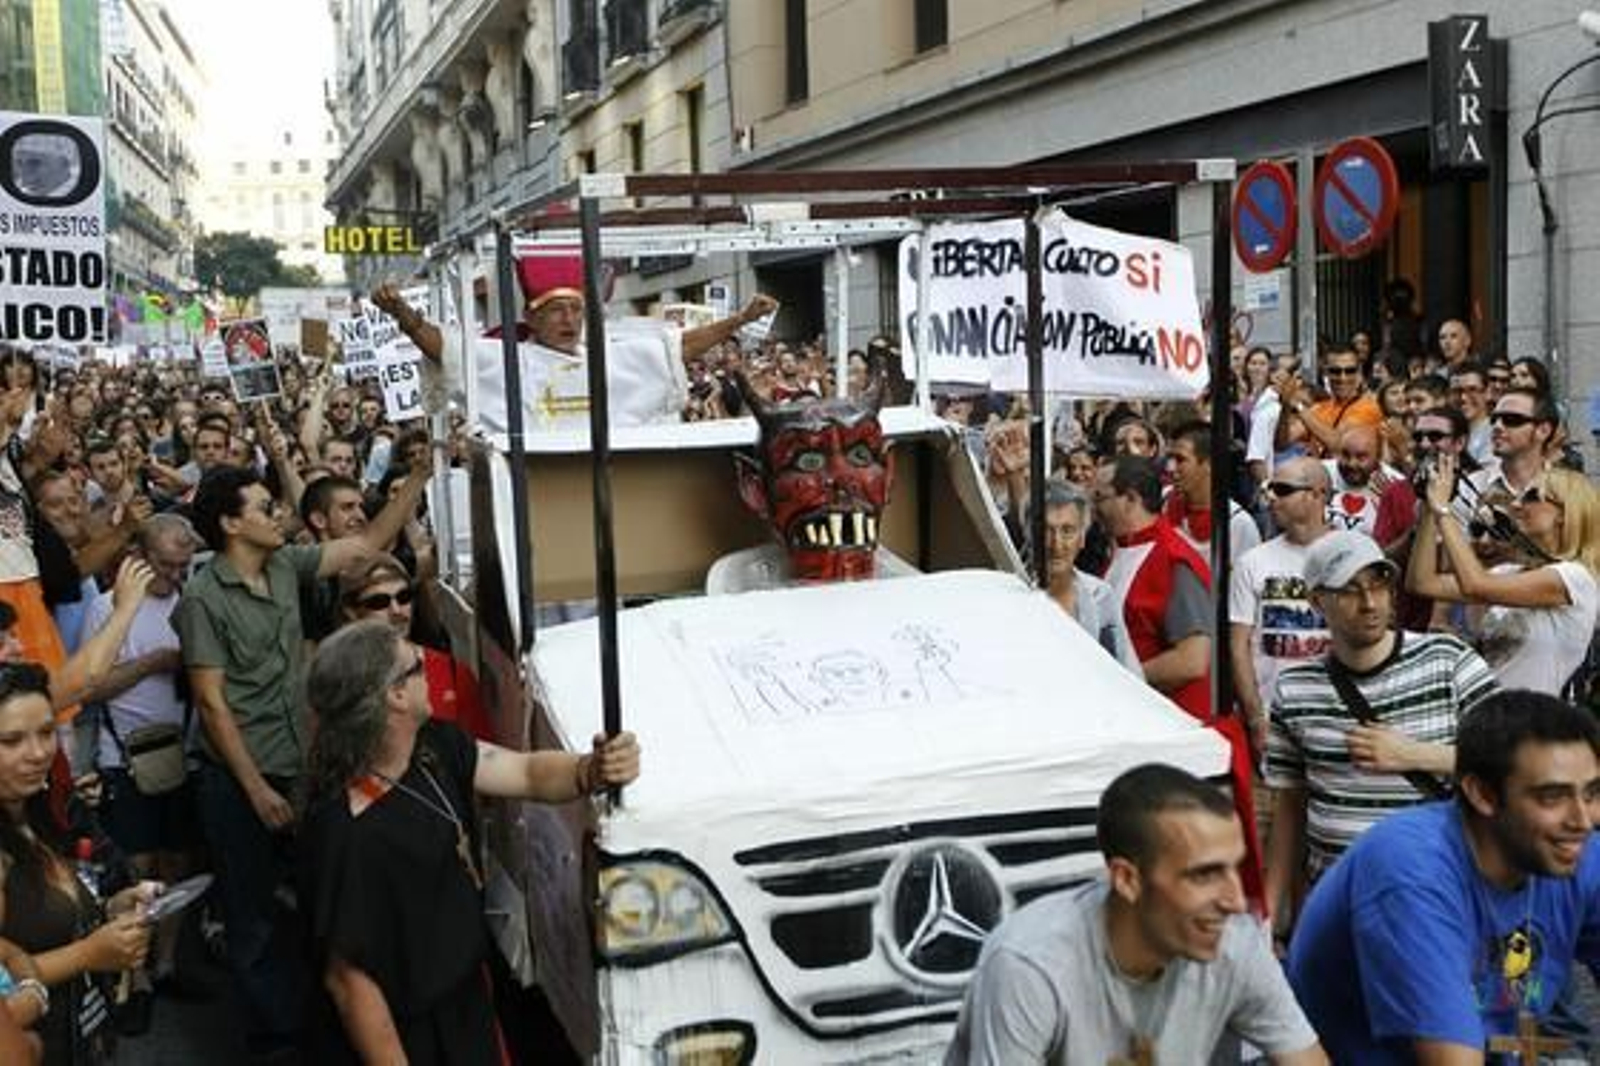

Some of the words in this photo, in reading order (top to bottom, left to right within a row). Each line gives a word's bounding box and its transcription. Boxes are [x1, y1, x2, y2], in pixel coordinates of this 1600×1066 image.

[1458, 20, 1484, 162] ZARA
[14, 213, 100, 236] IMPUESTOS
[326, 226, 422, 252] HOTEL
[1044, 238, 1120, 276] CULTO
[0, 303, 104, 342] ICO!
[1157, 327, 1203, 373] NO
